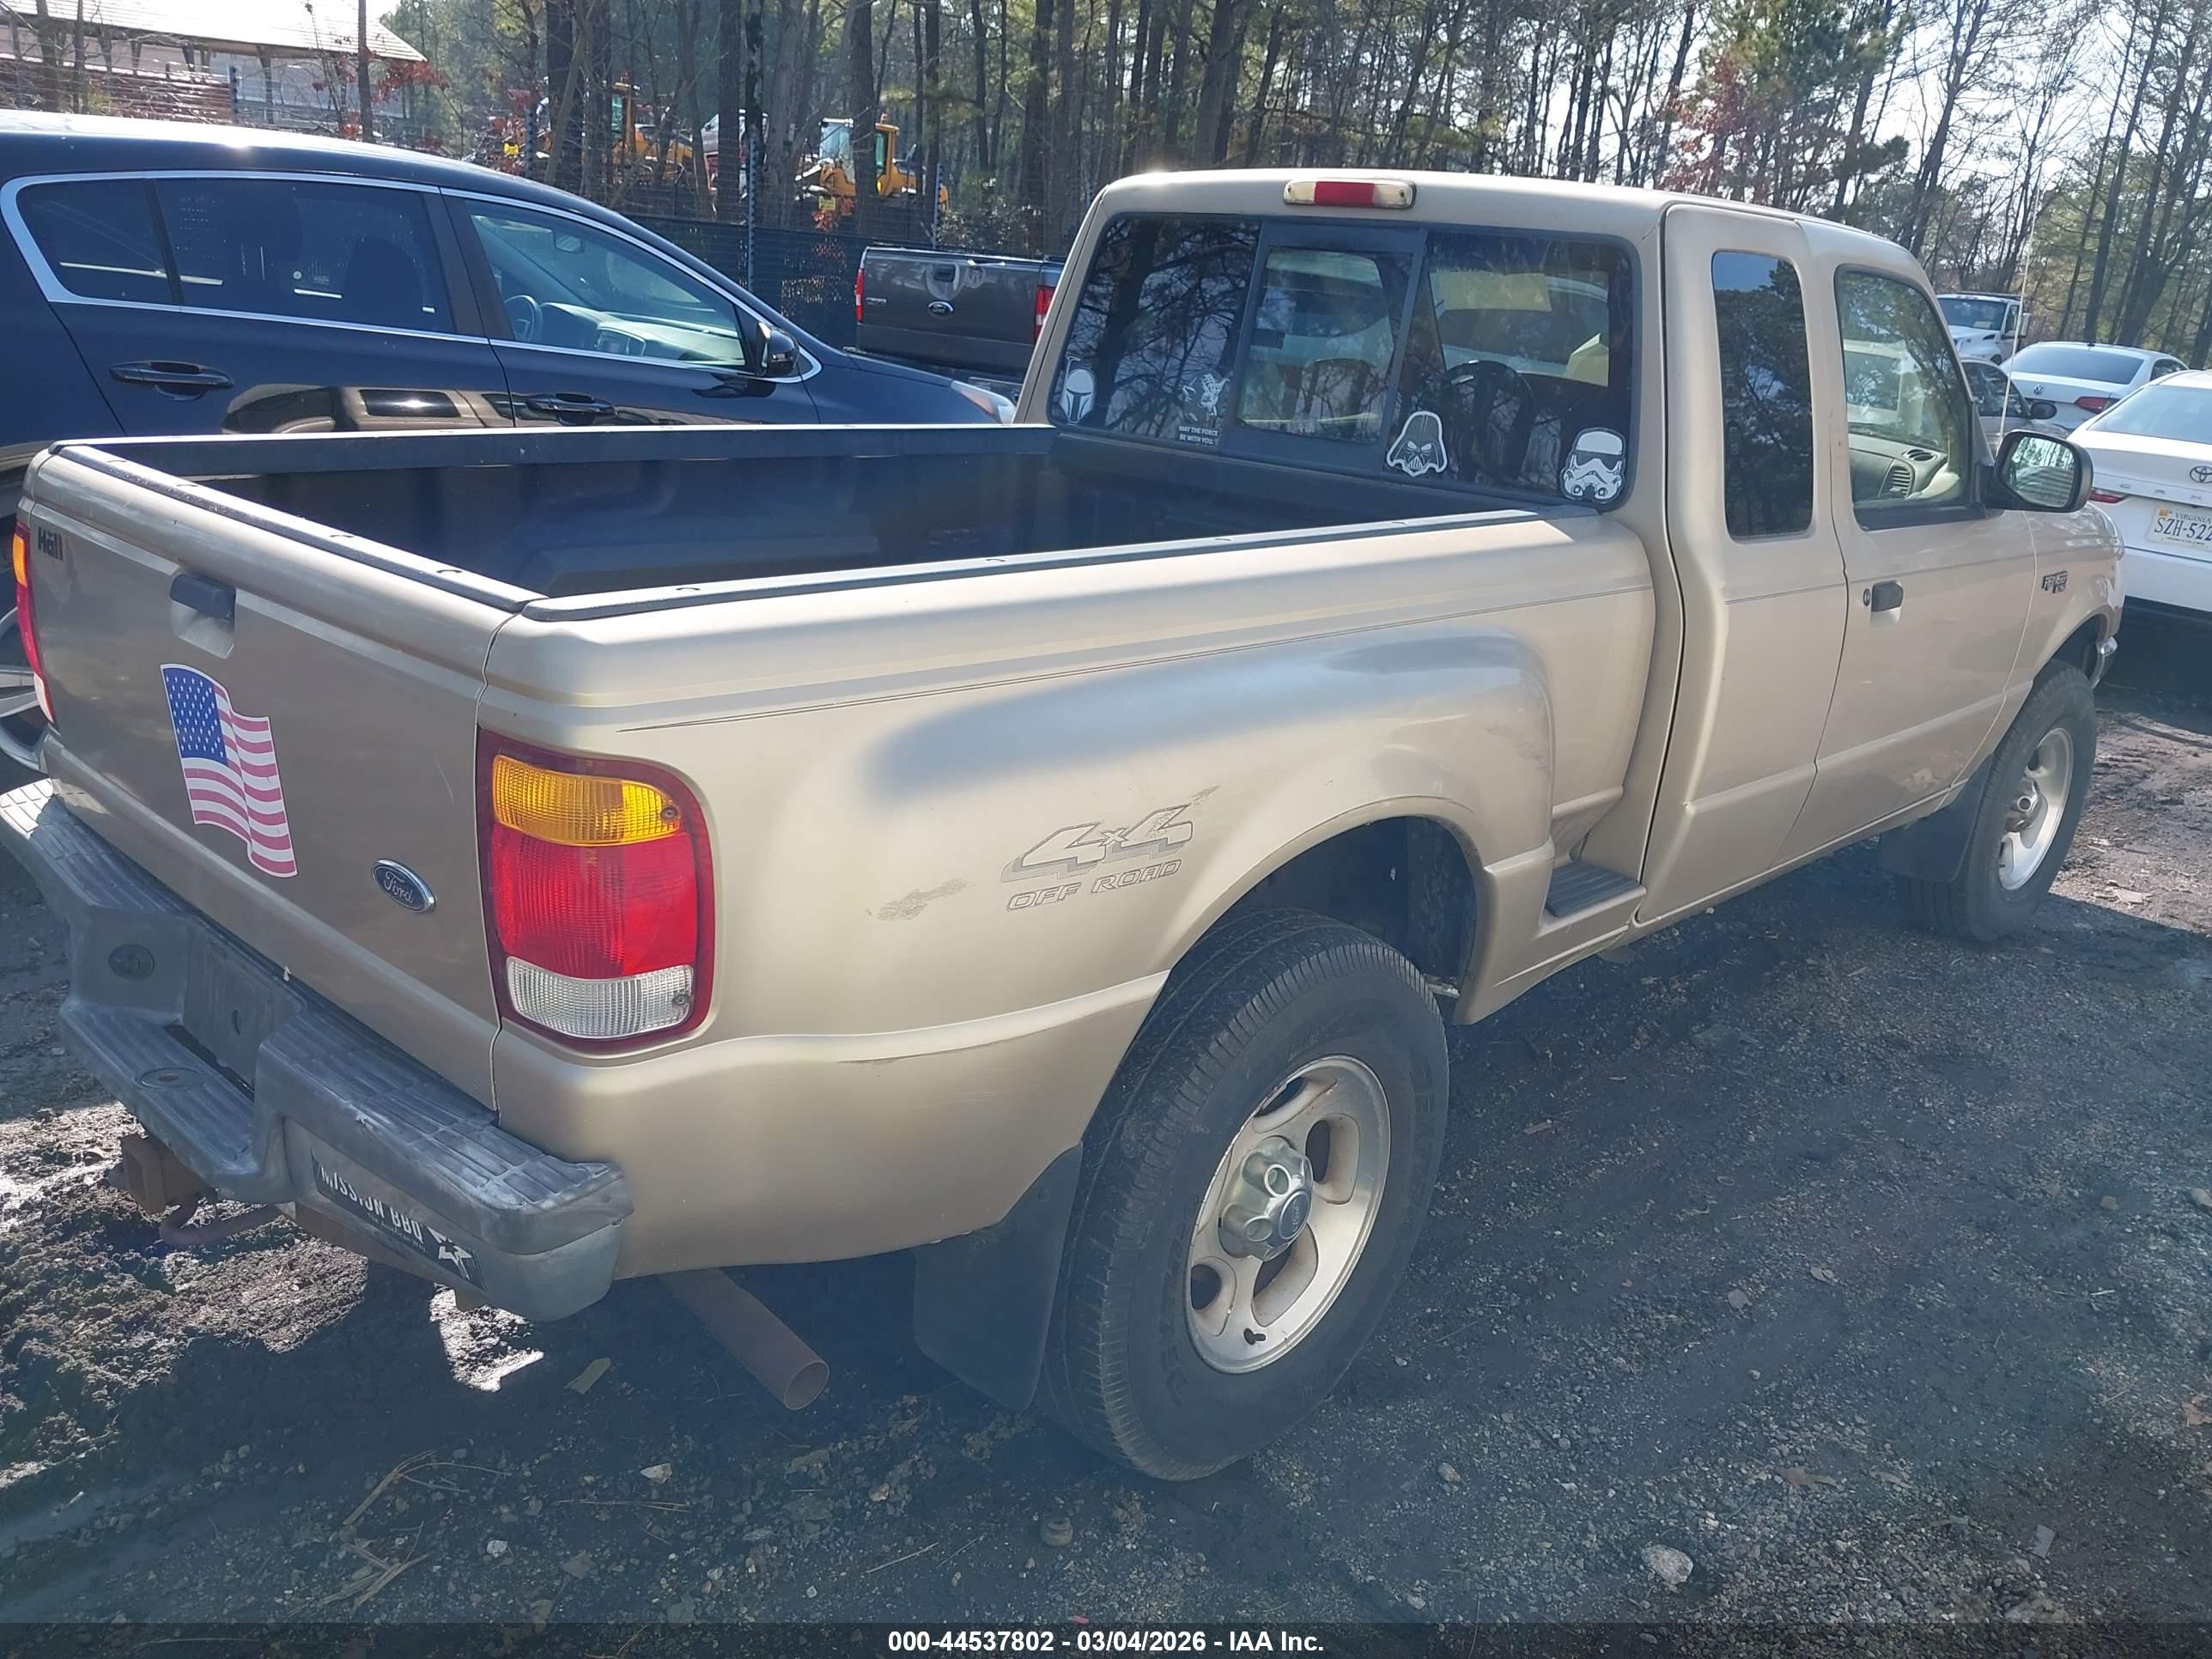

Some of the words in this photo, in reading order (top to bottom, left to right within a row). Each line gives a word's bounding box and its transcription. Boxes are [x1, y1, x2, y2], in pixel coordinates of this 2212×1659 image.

[2174, 512, 2211, 524] VIRGINIA
[384, 870, 414, 903] Ford
[1006, 882, 1082, 911] OFF
[1091, 859, 1182, 894] ROAD
